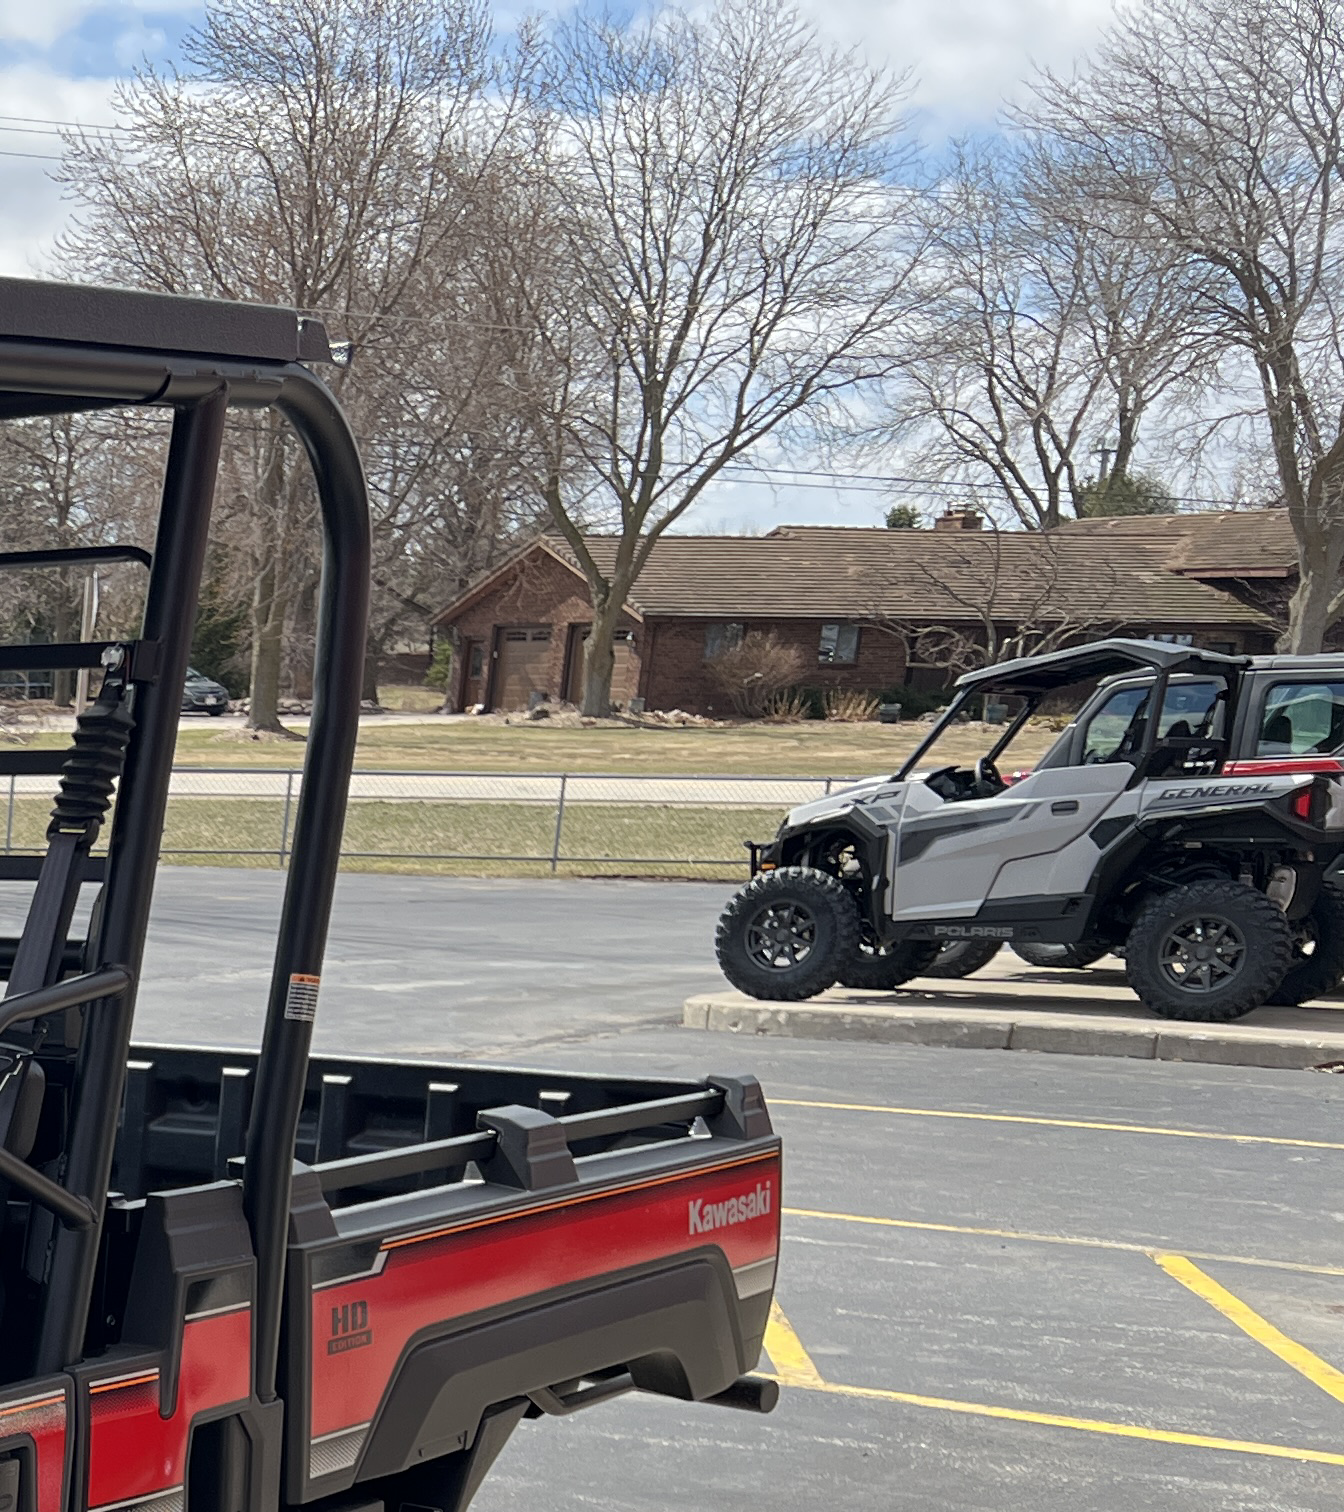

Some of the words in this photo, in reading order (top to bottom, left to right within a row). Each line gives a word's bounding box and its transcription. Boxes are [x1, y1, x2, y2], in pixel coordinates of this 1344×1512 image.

[1159, 783, 1273, 800] GENERAL
[934, 925, 1014, 938] POLARIS
[688, 1180, 771, 1235] Kawasaki
[331, 1300, 368, 1337] HD
[331, 1335, 369, 1352] EDITION
